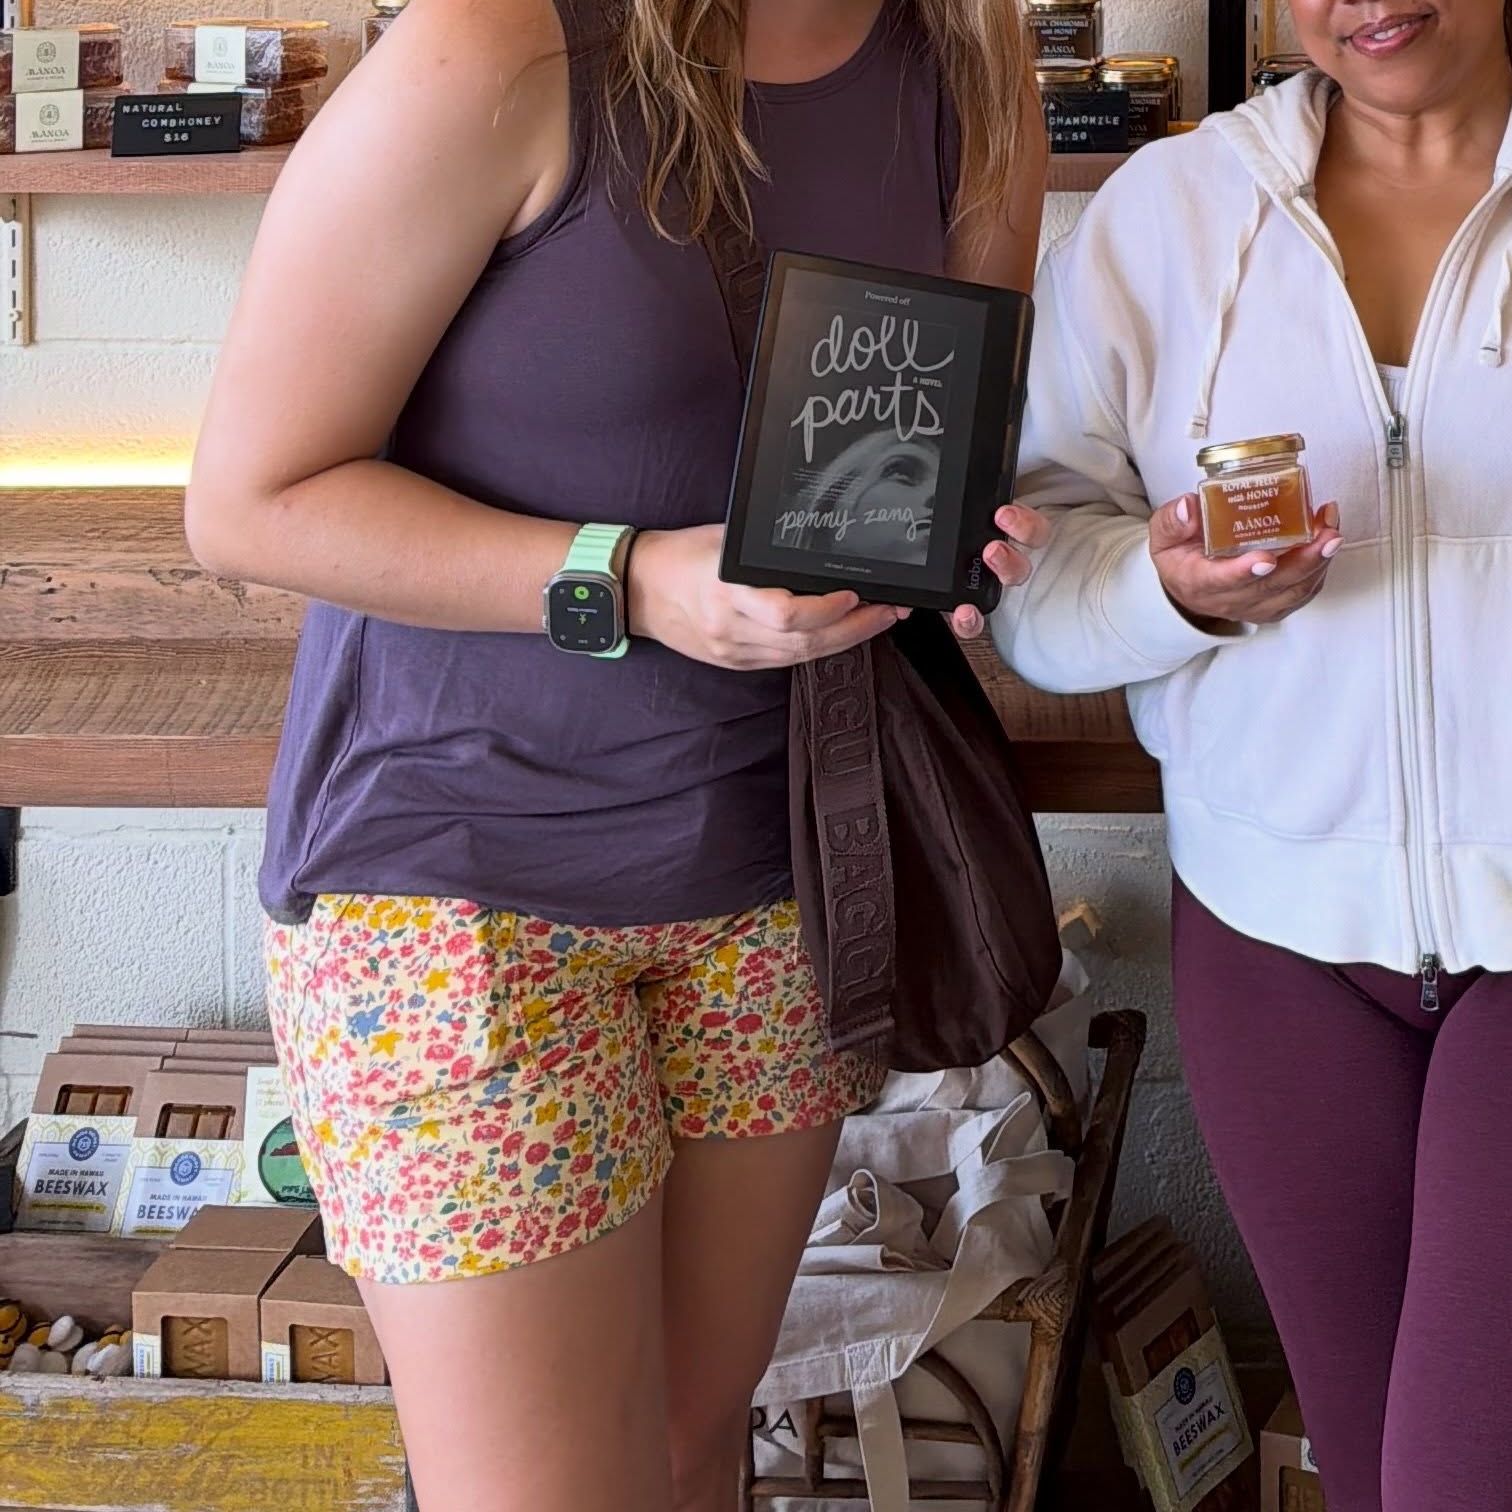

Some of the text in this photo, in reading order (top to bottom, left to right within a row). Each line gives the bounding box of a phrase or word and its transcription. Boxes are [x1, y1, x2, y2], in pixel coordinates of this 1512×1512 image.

[122, 103, 183, 114] NATURAL
[142, 116, 221, 128] COMBHONEY
[1049, 115, 1120, 126] CHAMOMILE
[164, 133, 189, 143] $16
[864, 290, 911, 307] Powered off
[811, 315, 954, 377] doll
[913, 376, 943, 388] A NOVEL
[791, 372, 944, 464] parts
[1221, 474, 1280, 493] ROYAL JELLY
[1246, 487, 1280, 501] HONEY
[775, 506, 932, 543] penny zang
[967, 556, 982, 591] kobo
[48, 1169, 104, 1177] MADE IN HAWAII
[34, 1179, 109, 1197] BEESWAX
[150, 1194, 171, 1202] MADE
[173, 1194, 180, 1202] IN
[1172, 1401, 1226, 1457] BEESWAX
